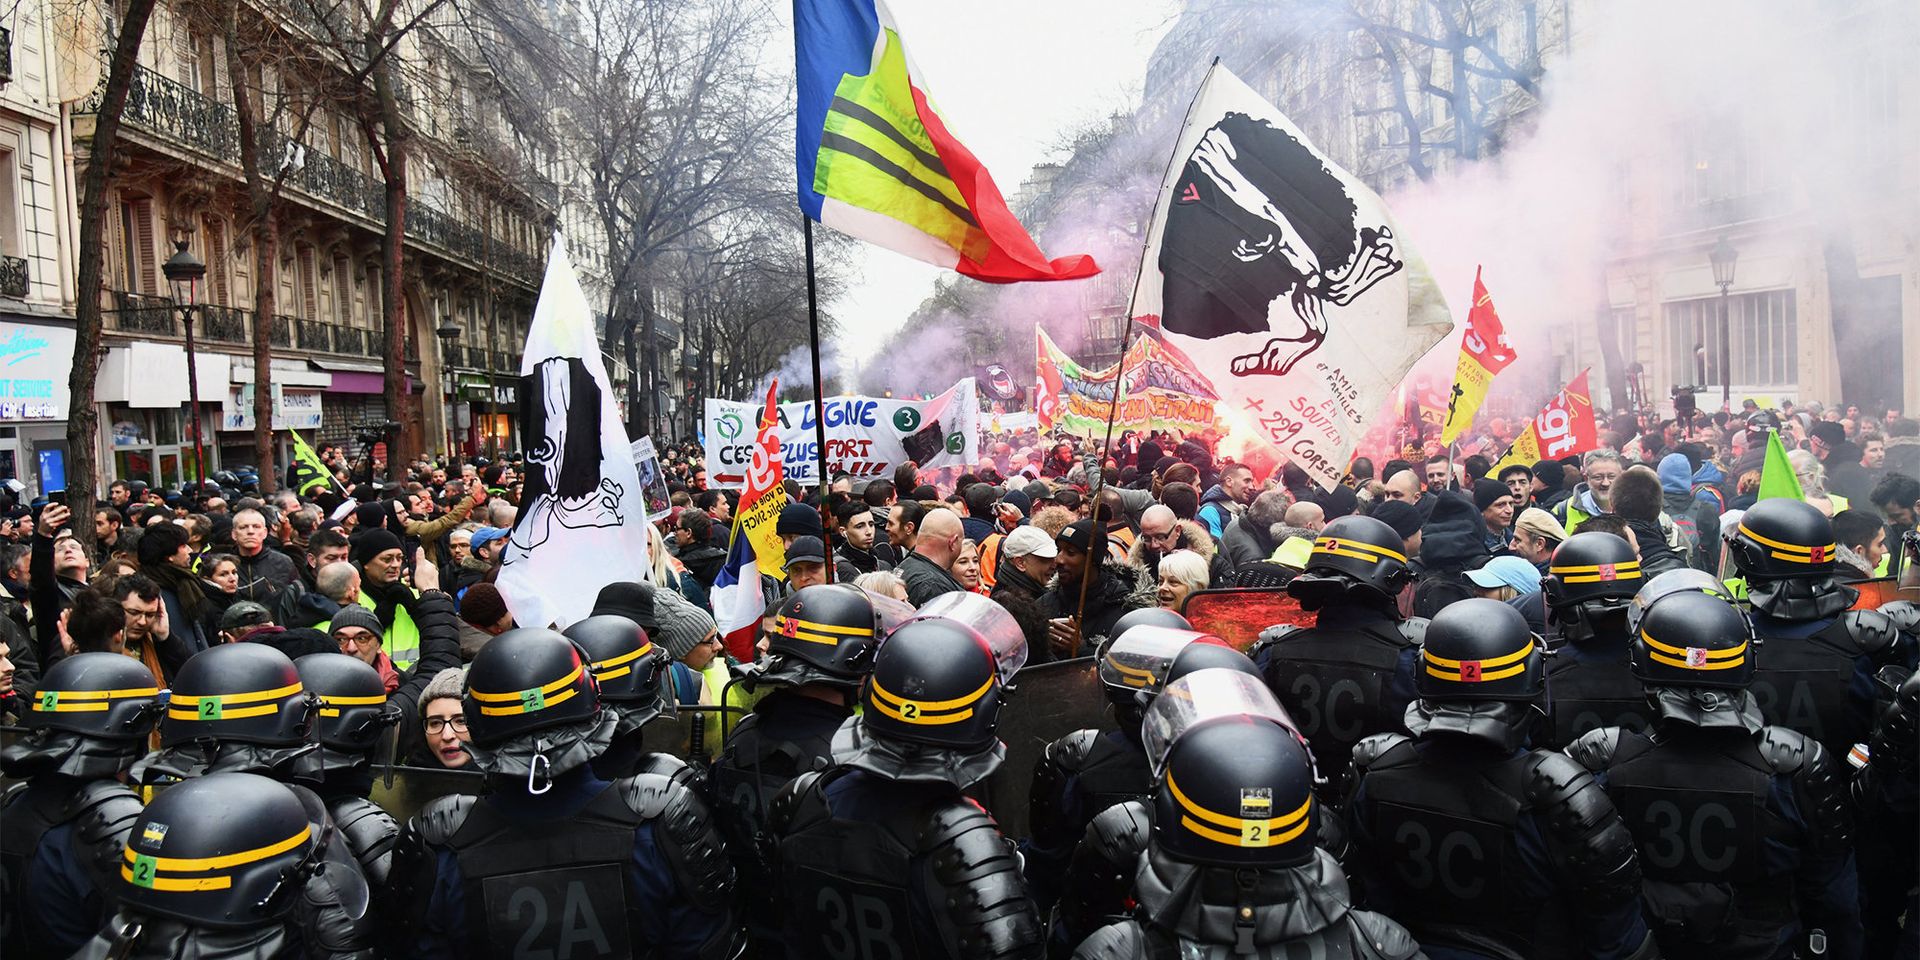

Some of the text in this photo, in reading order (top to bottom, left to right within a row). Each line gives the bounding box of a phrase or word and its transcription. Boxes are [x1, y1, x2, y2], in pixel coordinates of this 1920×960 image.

[13, 379, 53, 398] SERVICE
[1333, 368, 1358, 400] AMIS
[283, 393, 313, 408] ERINAIRE
[1320, 399, 1338, 418] EN
[1326, 375, 1362, 424] FAMILLES
[801, 400, 878, 431] LGNE
[1289, 396, 1343, 447] SOUTIEN
[1259, 410, 1303, 445] 229
[719, 438, 873, 466] C'ES PLUS FORT
[1327, 539, 1337, 551] 2
[1465, 664, 1476, 678] 2
[45, 695, 54, 708] 2
[204, 701, 216, 717] 2
[904, 704, 917, 719] 2
[1250, 825, 1262, 842] 2
[1644, 800, 1737, 873] 3C
[1394, 820, 1486, 899] 3C
[138, 862, 149, 881] 2
[507, 879, 612, 960] 2A
